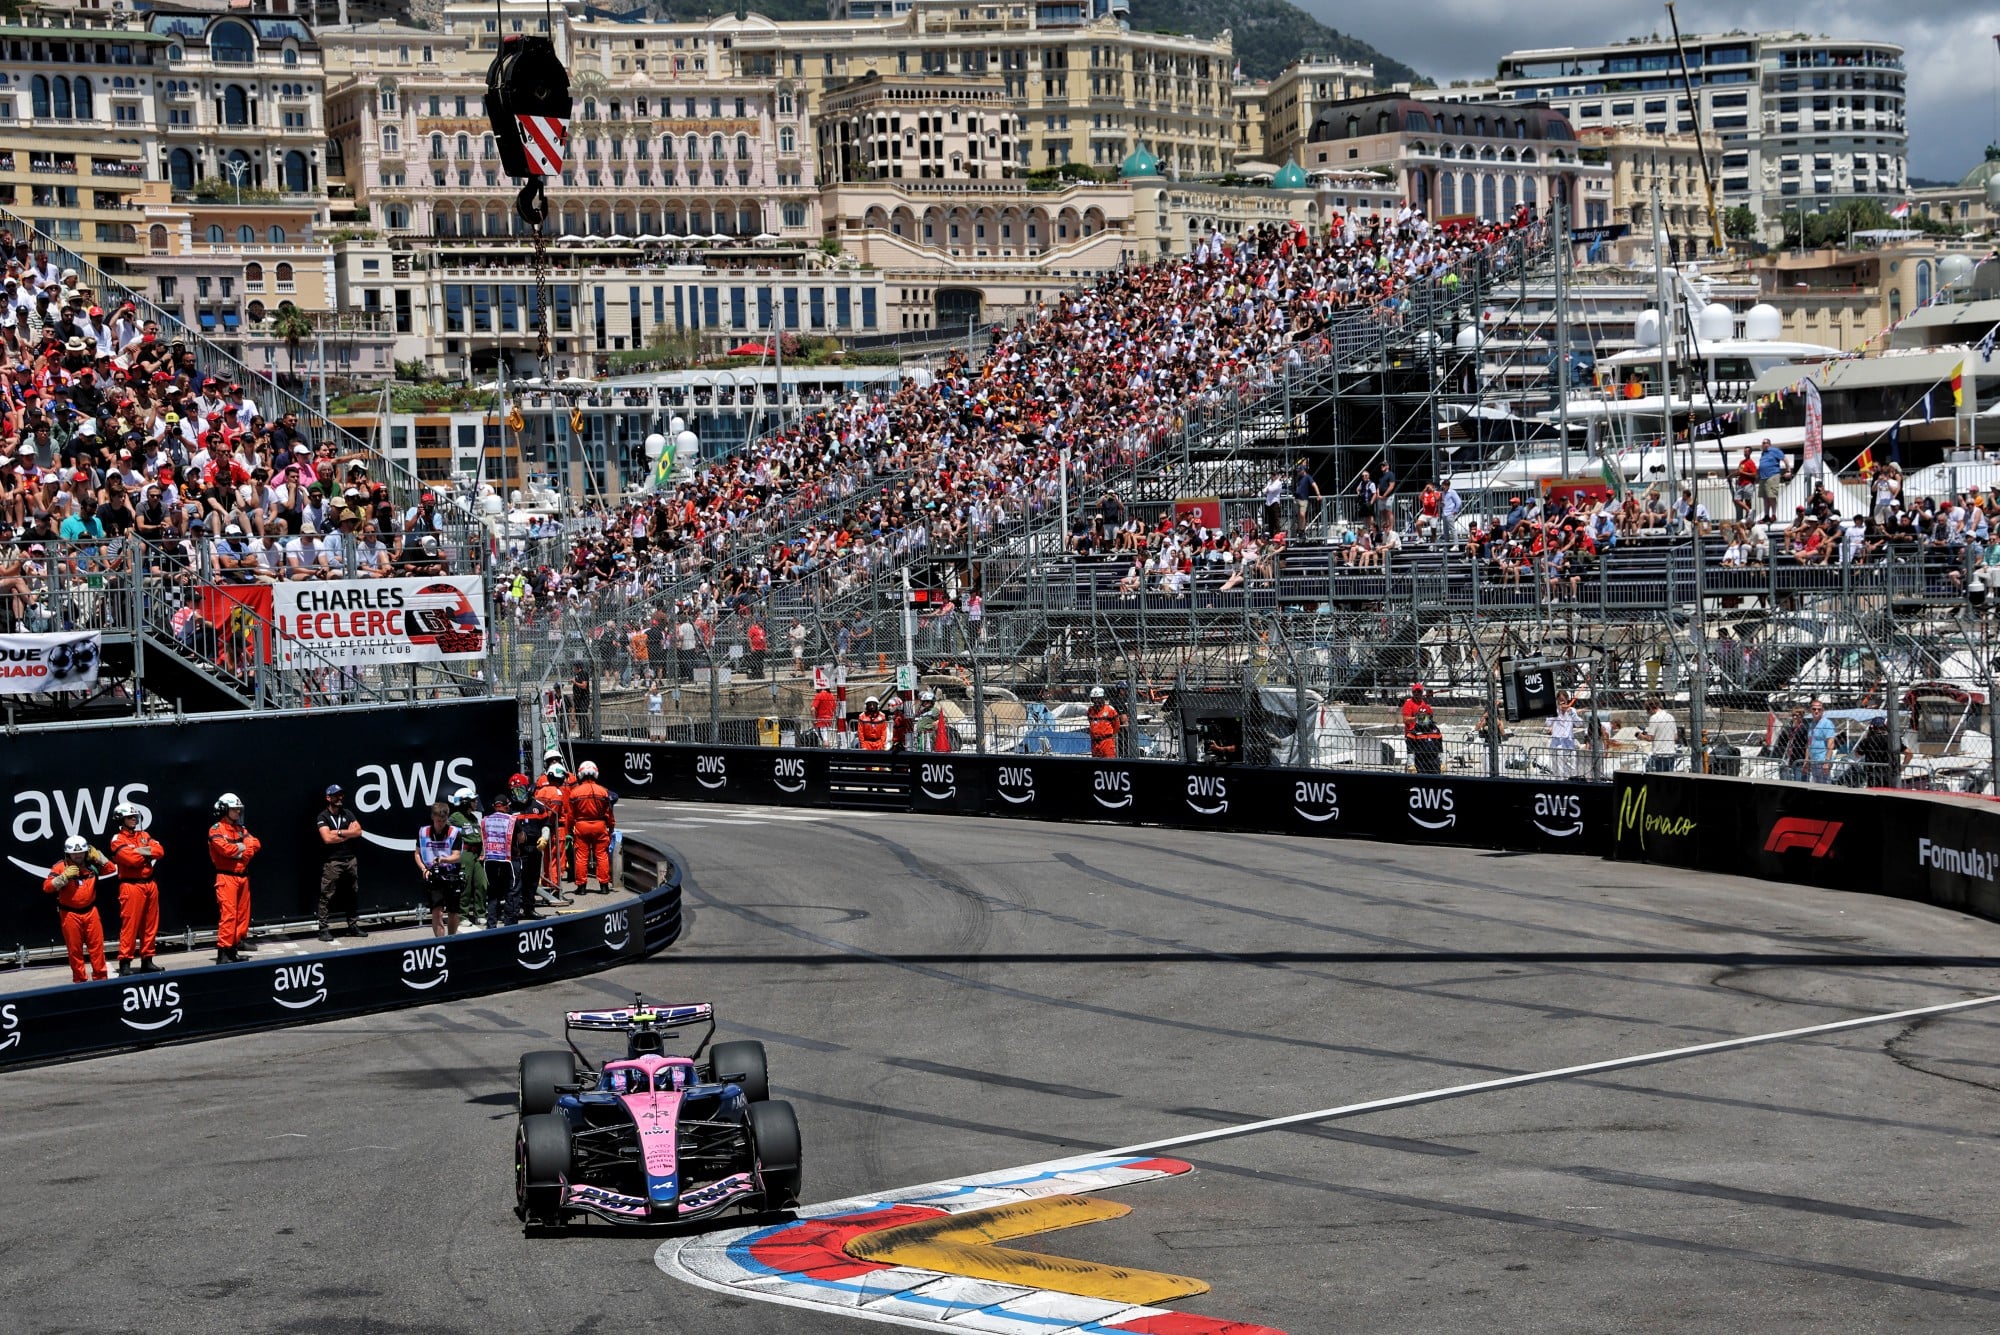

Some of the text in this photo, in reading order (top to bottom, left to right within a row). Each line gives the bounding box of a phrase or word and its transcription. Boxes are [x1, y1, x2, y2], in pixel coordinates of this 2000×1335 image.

[296, 588, 404, 612] CHARLES
[280, 611, 404, 640] LECLERC
[308, 641, 333, 650] THE
[352, 647, 375, 656] FAN
[382, 645, 411, 655] CLUB
[1524, 673, 1543, 686] aws
[624, 753, 652, 769] aws
[697, 756, 725, 773] aws
[775, 759, 804, 777] aws
[354, 757, 477, 813] aws
[922, 764, 953, 783] aws
[999, 767, 1032, 786] aws
[1095, 771, 1130, 791] aws
[1188, 776, 1225, 797] aws
[1296, 782, 1336, 803] aws
[1410, 787, 1453, 810] aws
[1535, 793, 1580, 817] aws
[12, 783, 152, 842] aws
[1618, 784, 1697, 850] Monaco
[605, 910, 628, 934] aws
[519, 928, 554, 953] aws
[403, 945, 447, 972] aws
[275, 963, 324, 991] aws
[123, 982, 180, 1011] aws
